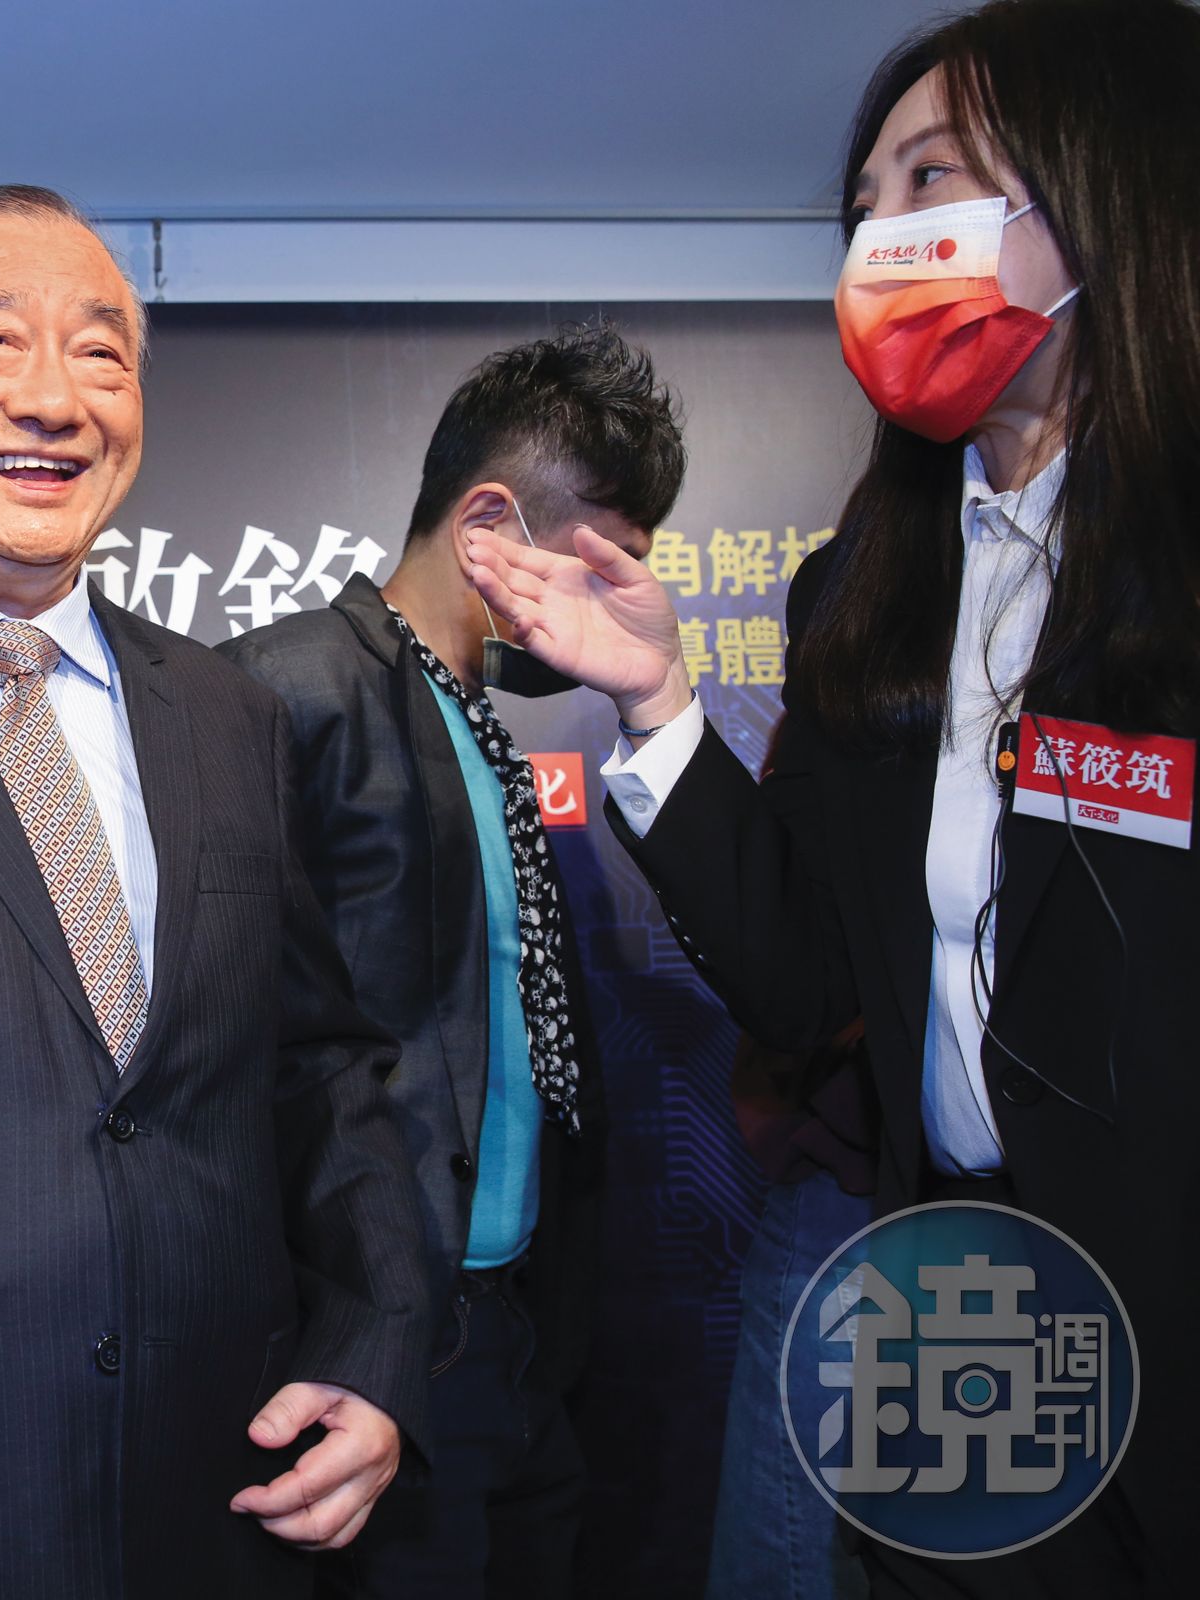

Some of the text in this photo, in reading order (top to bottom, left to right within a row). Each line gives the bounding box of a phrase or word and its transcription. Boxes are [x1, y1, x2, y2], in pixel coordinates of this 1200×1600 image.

[1032, 735, 1174, 799] 蘇筱筑
[1078, 805, 1118, 822] 天下文化
